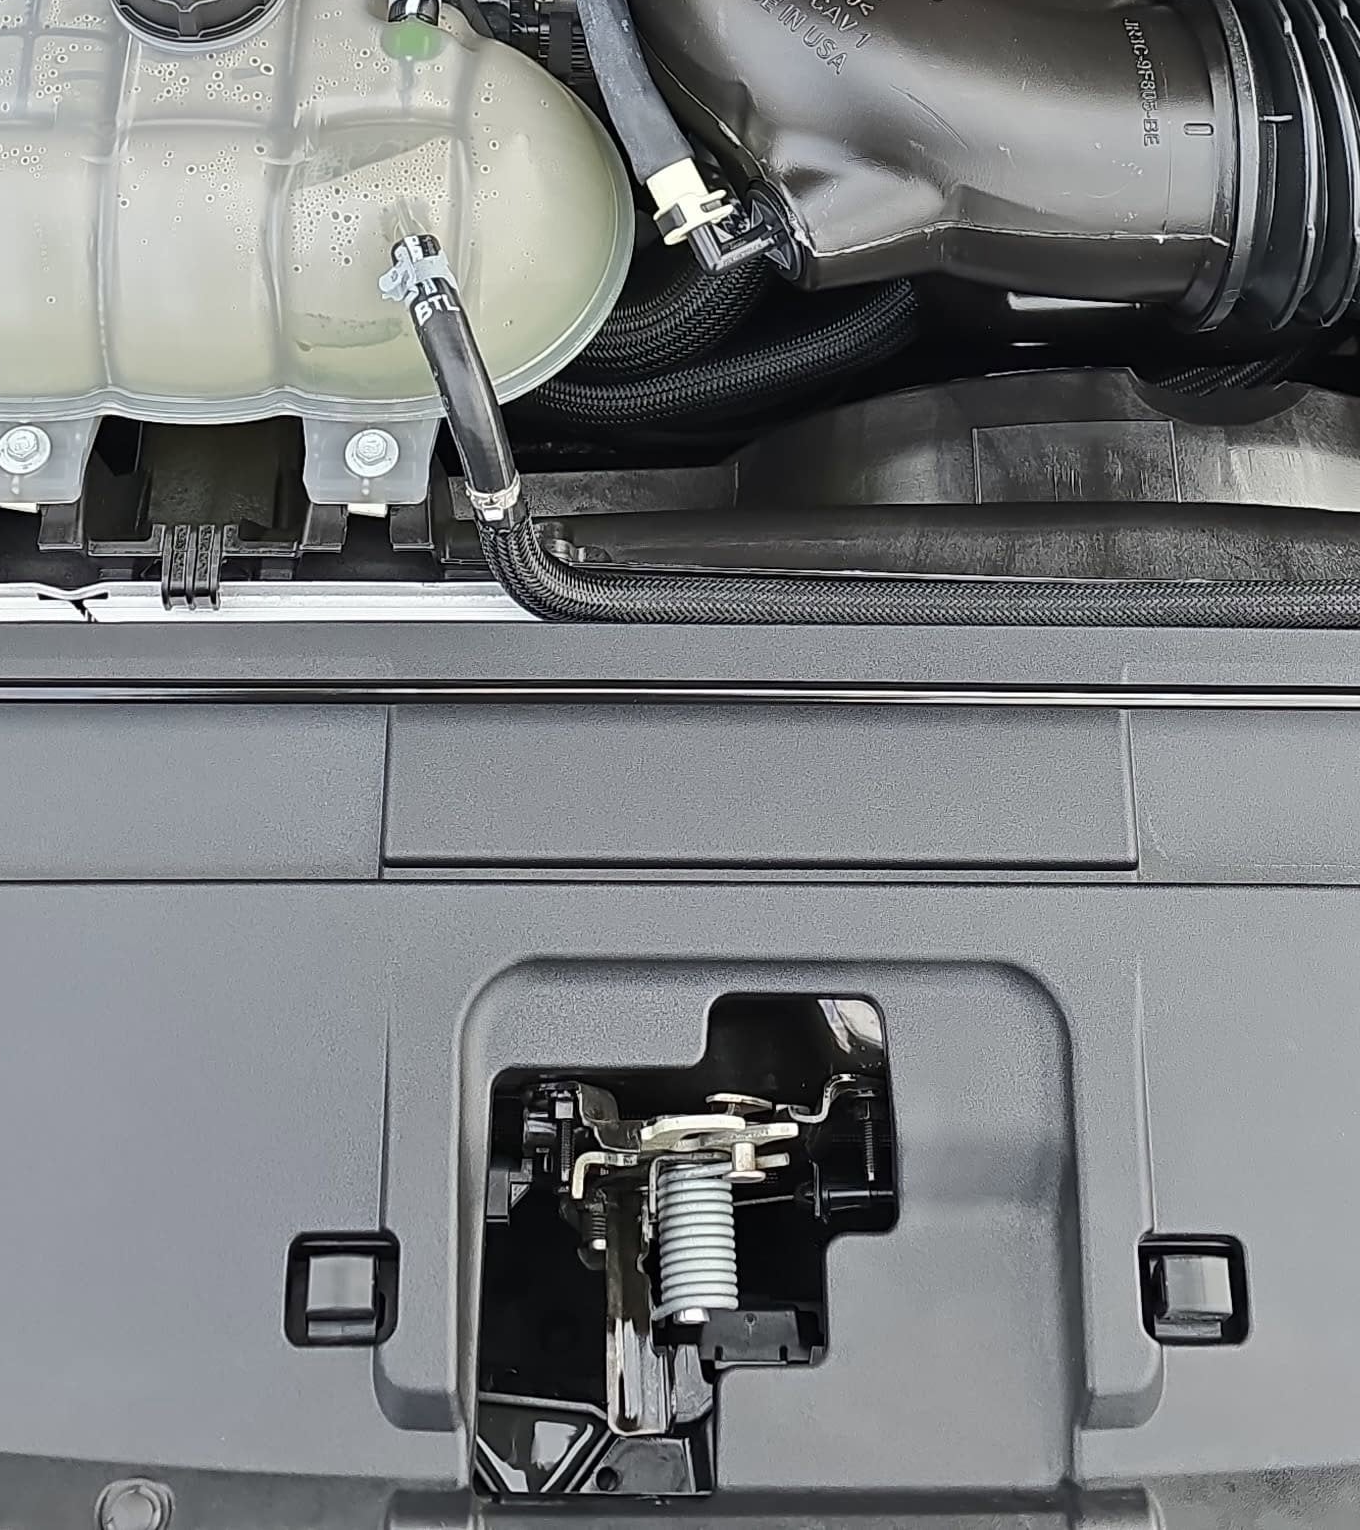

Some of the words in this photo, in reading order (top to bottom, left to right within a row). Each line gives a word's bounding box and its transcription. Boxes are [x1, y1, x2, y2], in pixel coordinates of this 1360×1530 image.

[777, 3, 808, 32] IN
[802, 24, 848, 75] USA
[414, 293, 461, 327] BTL
